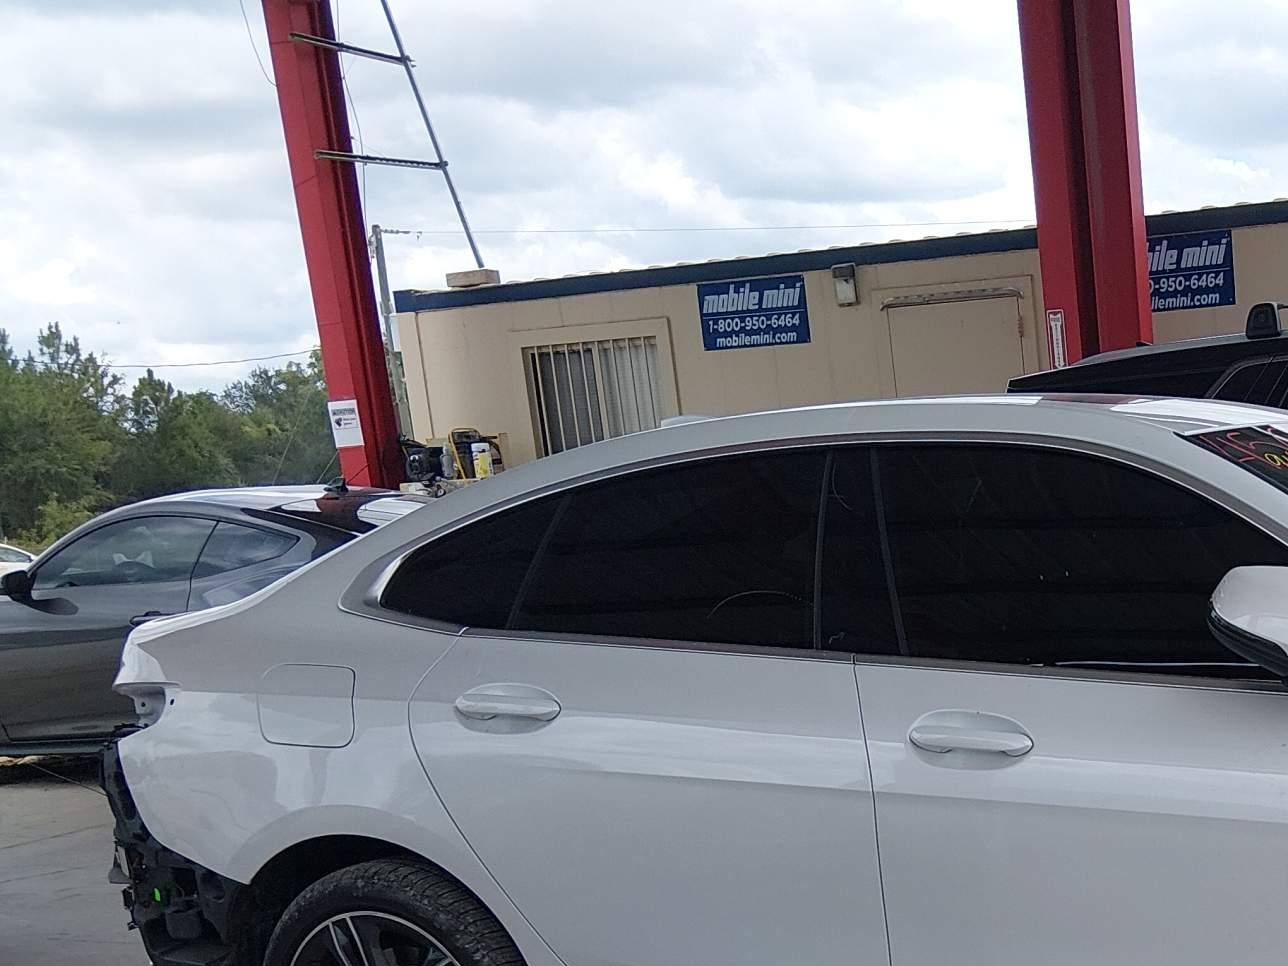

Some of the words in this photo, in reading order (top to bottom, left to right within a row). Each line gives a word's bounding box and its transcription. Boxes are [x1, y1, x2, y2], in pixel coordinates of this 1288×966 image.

[1180, 239, 1226, 268] mini
[703, 283, 760, 313] mobile
[762, 283, 801, 309] mini
[708, 313, 800, 333] 1-800-950-6464
[716, 331, 797, 347] mobilemini.com
